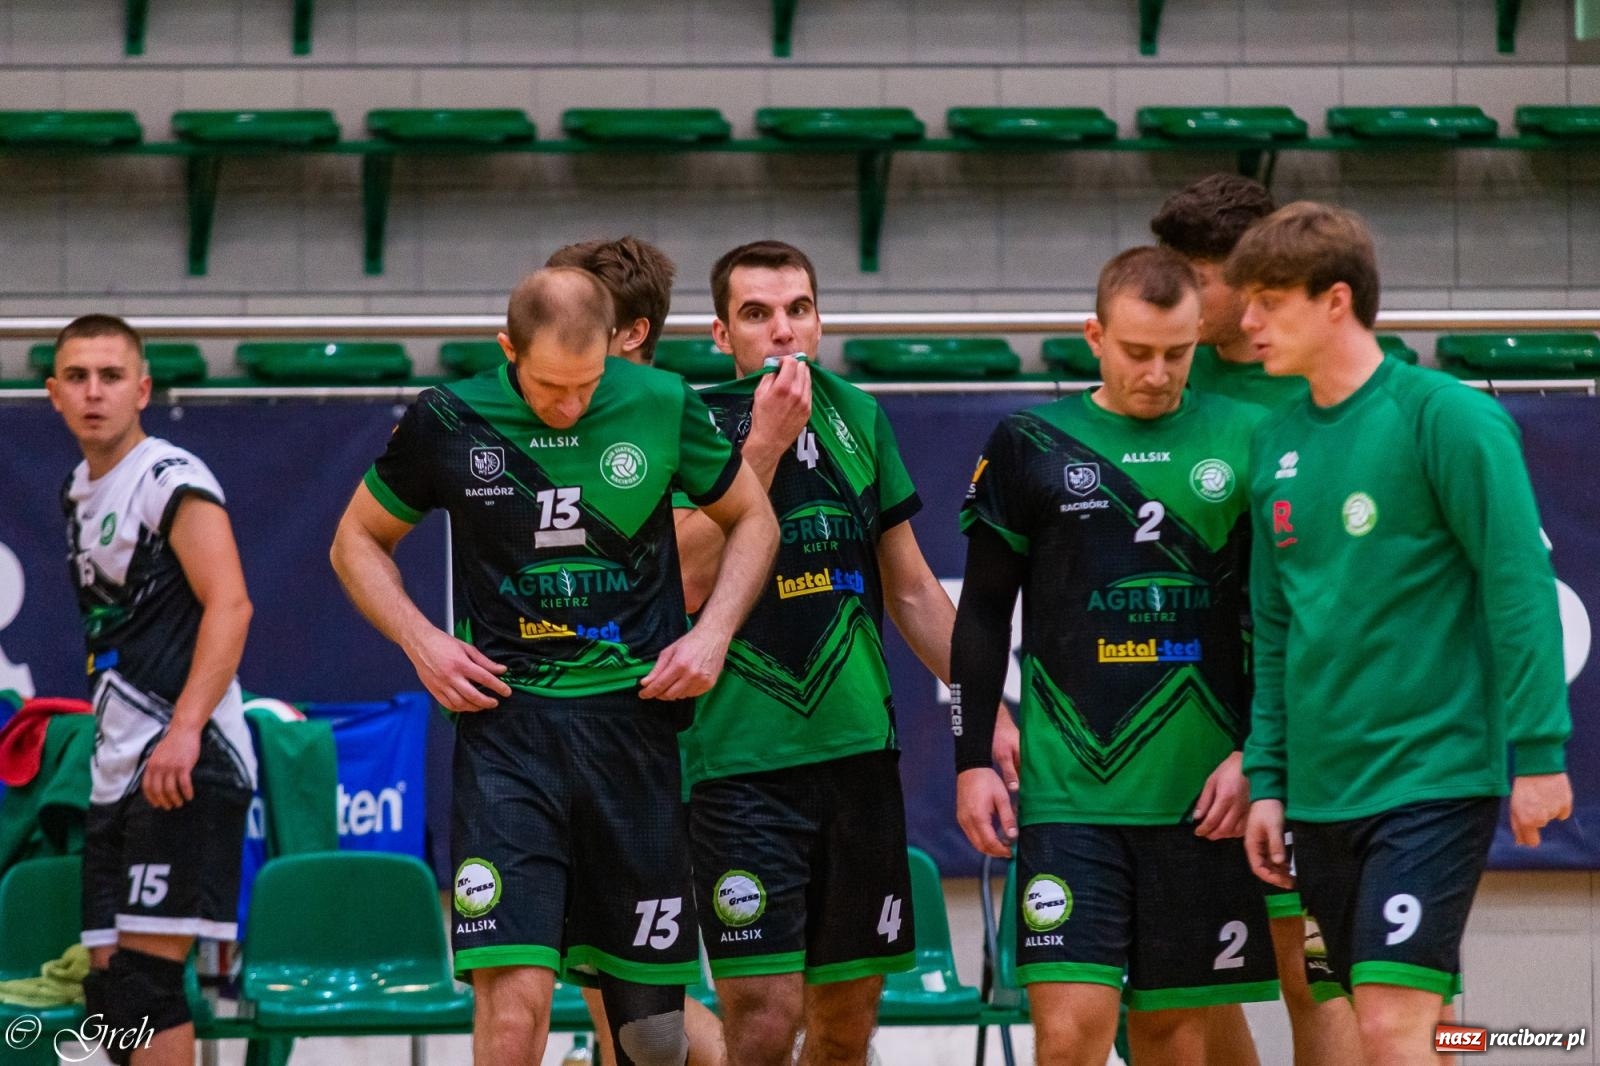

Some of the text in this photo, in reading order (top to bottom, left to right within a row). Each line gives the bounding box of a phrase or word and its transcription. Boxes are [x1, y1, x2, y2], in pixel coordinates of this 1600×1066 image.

[529, 436, 579, 448] ALLSIX
[797, 427, 819, 469] 4
[1122, 452, 1171, 463] ALLSIX
[465, 485, 515, 497] RACIBÓRZ
[536, 487, 581, 530] 13
[1060, 498, 1110, 513] RACIBÓRZ
[1134, 501, 1165, 543] 2
[1273, 500, 1294, 534] R
[499, 567, 629, 597] AGROTIM
[541, 597, 589, 609] KIETRZ
[1088, 584, 1210, 611] AGROTIM
[1128, 612, 1177, 624] KIETRZ
[128, 863, 171, 906] 15
[466, 882, 494, 896] Grass
[729, 893, 760, 907] Grass
[1035, 899, 1065, 911] Grass
[633, 897, 683, 950] 13
[877, 894, 902, 943] 4
[1383, 894, 1422, 946] 9
[456, 919, 497, 935] ALLSIX
[720, 928, 763, 943] ALLSIX
[1025, 935, 1065, 948] ALLSIX
[1213, 920, 1249, 971] 2
